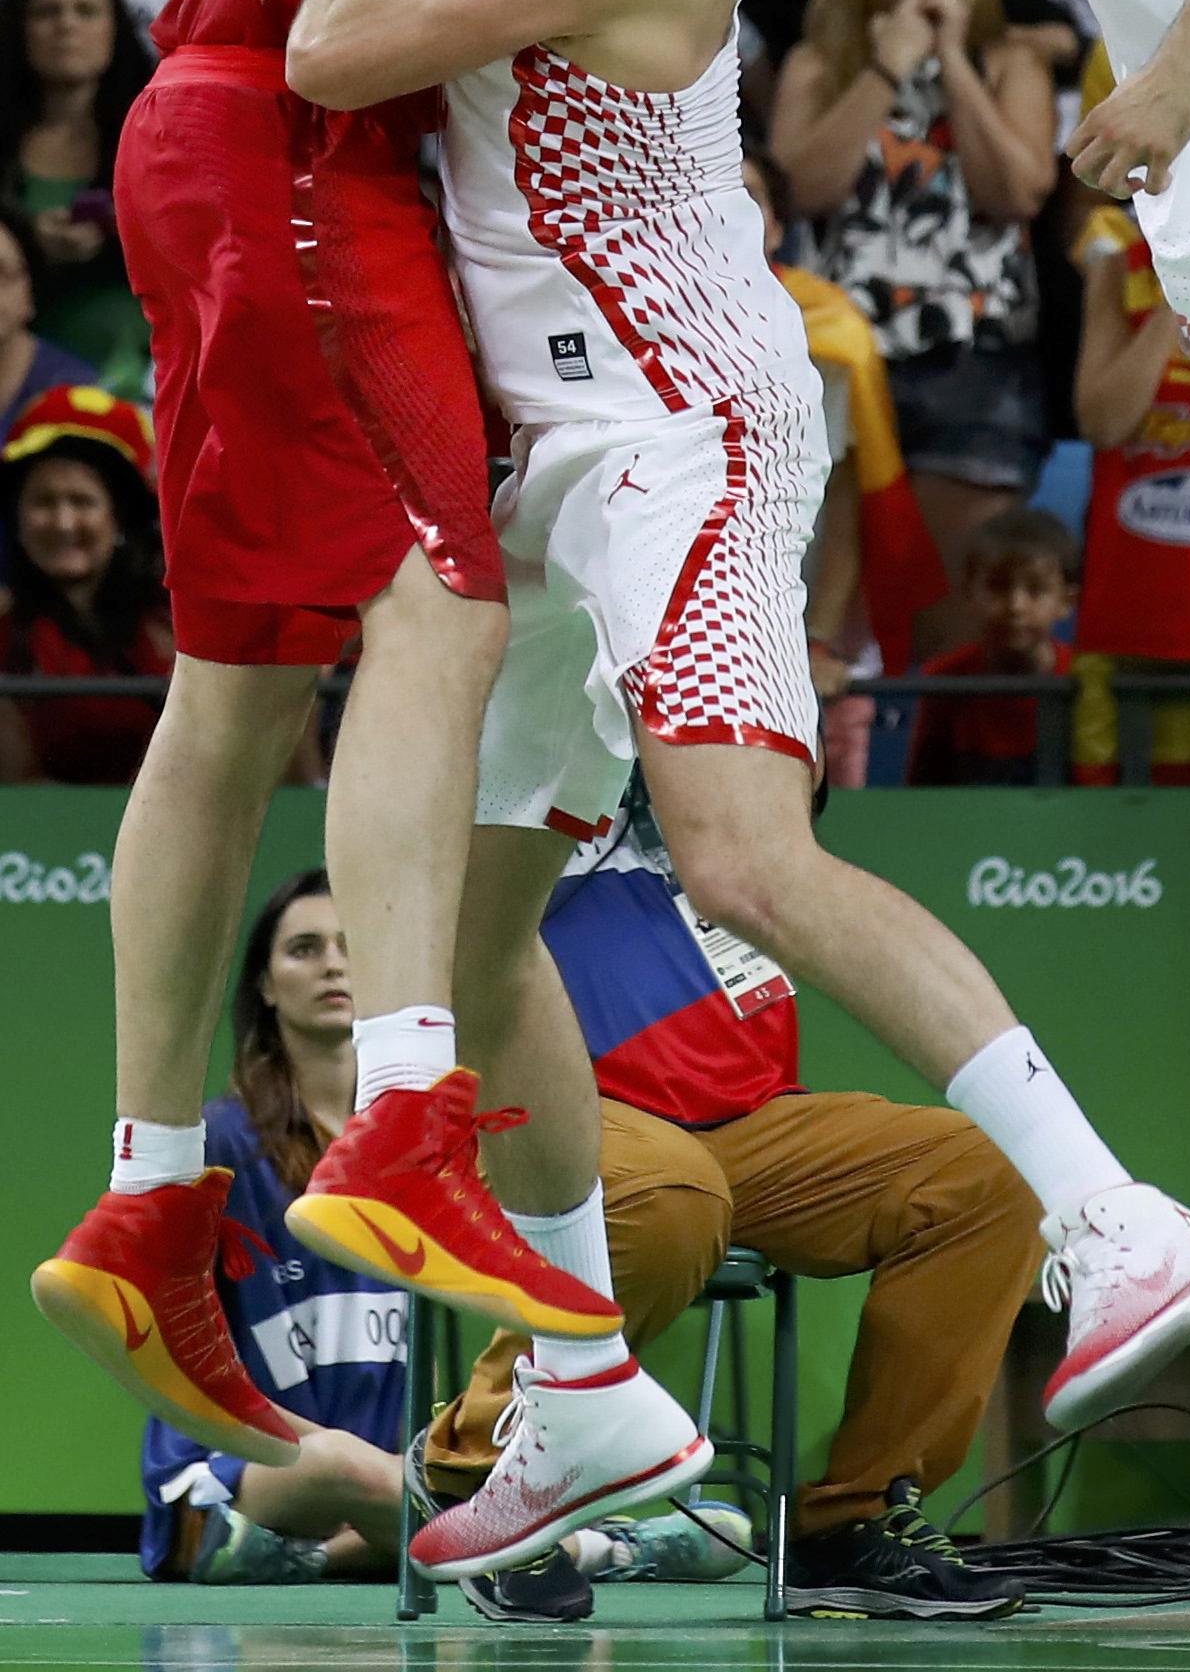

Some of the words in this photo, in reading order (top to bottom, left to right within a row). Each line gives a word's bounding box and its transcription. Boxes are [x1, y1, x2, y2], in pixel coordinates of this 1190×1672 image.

[557, 339, 577, 354] 54
[0, 852, 111, 903] Rio2
[968, 856, 1162, 907] Rio2016
